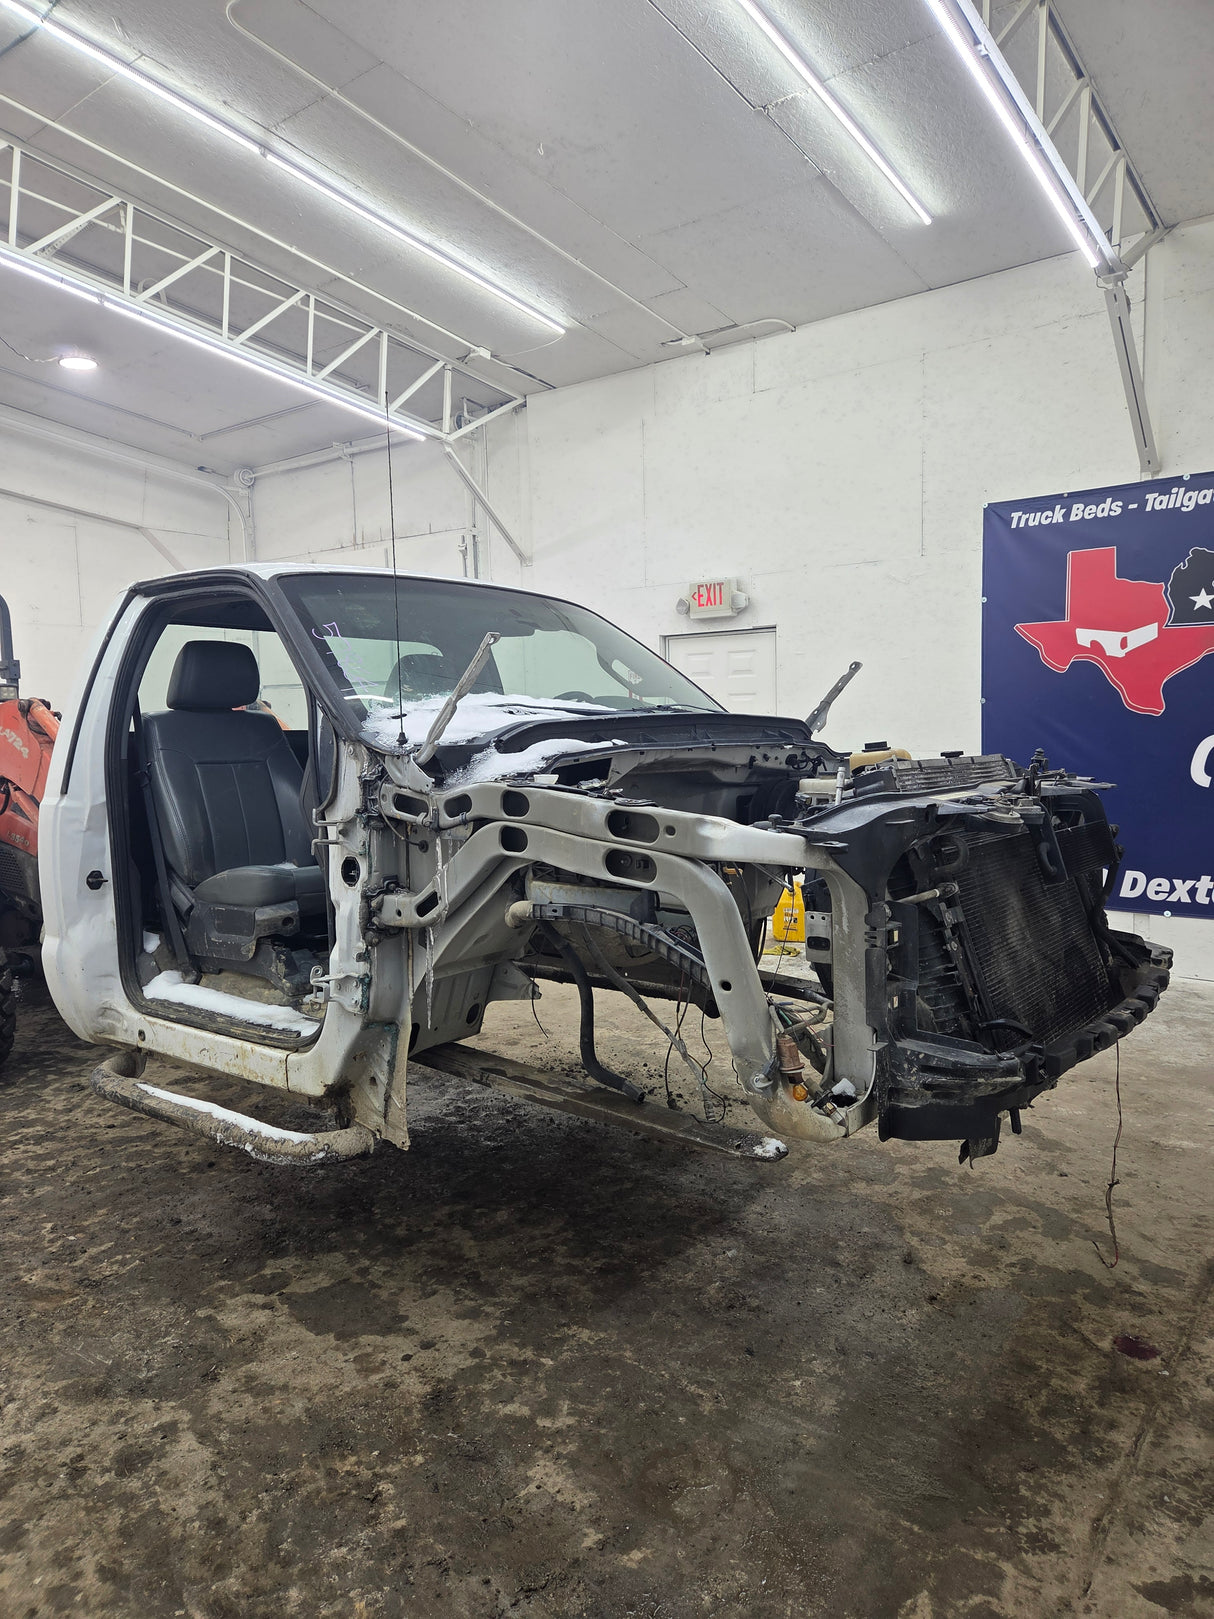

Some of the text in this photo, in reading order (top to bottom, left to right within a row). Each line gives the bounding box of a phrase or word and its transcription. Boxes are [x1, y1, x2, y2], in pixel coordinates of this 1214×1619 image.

[1010, 504, 1066, 529] Truck
[1069, 498, 1122, 522] Beds
[1145, 487, 1214, 512] Tailga
[697, 582, 724, 607] EXIT
[1119, 870, 1214, 905] Dext
